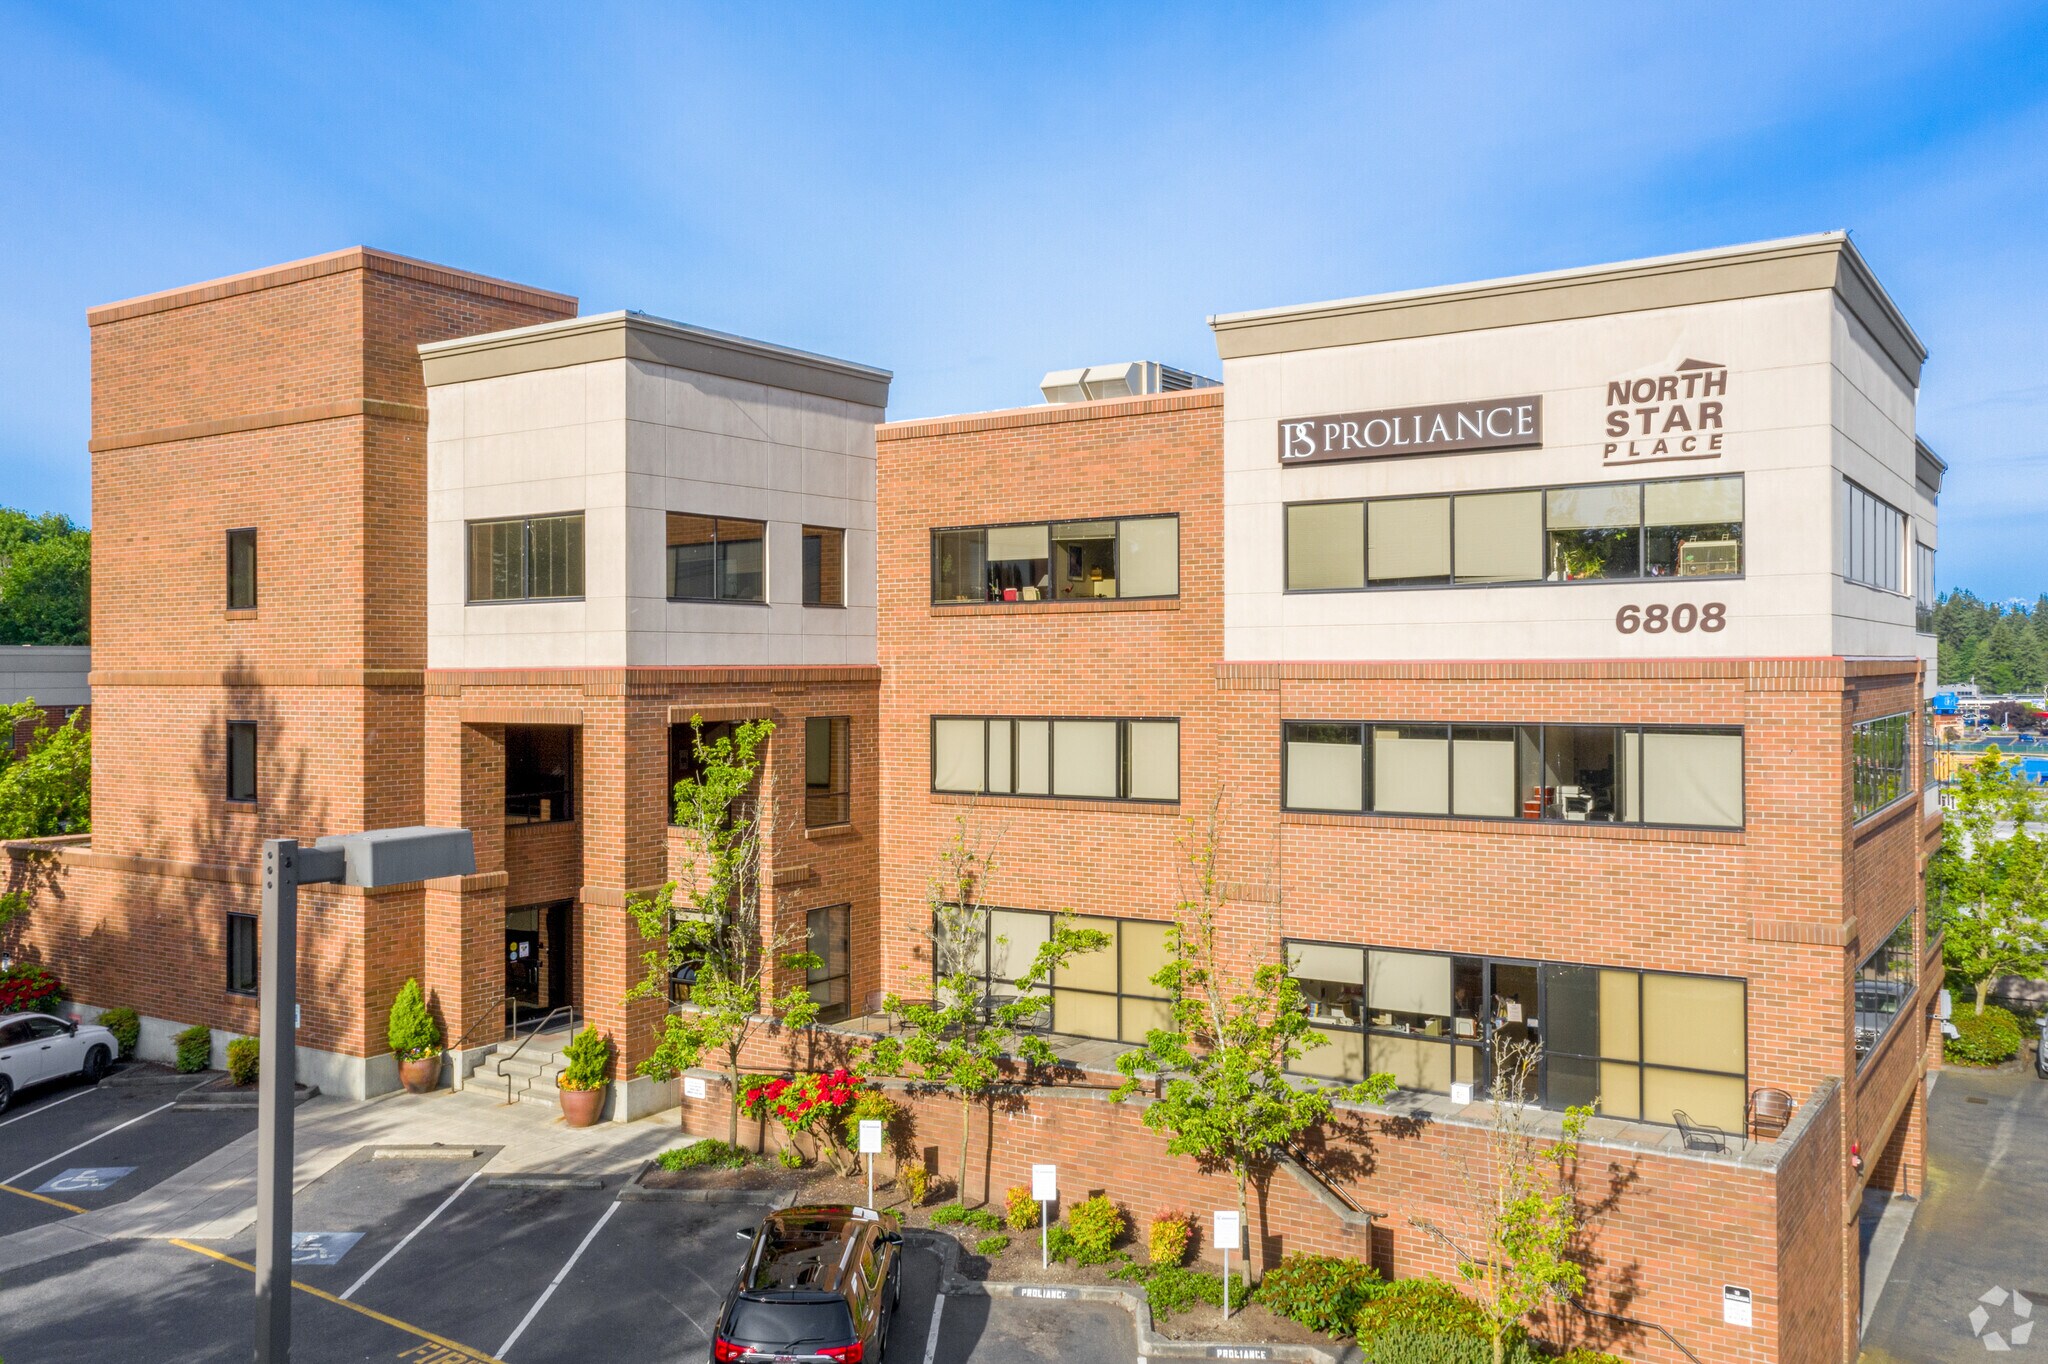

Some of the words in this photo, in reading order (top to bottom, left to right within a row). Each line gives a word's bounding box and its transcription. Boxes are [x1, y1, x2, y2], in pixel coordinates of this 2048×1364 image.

[1607, 370, 1728, 406] NORTH
[1323, 404, 1534, 452] PROLIANCE
[1606, 401, 1723, 438] STAR
[1603, 433, 1723, 459] PLACE
[1615, 602, 1727, 635] 6808
[1021, 1288, 1067, 1299] PROLIANCE
[397, 1341, 486, 1364] FIR
[1216, 1349, 1267, 1360] PROLIANCE
